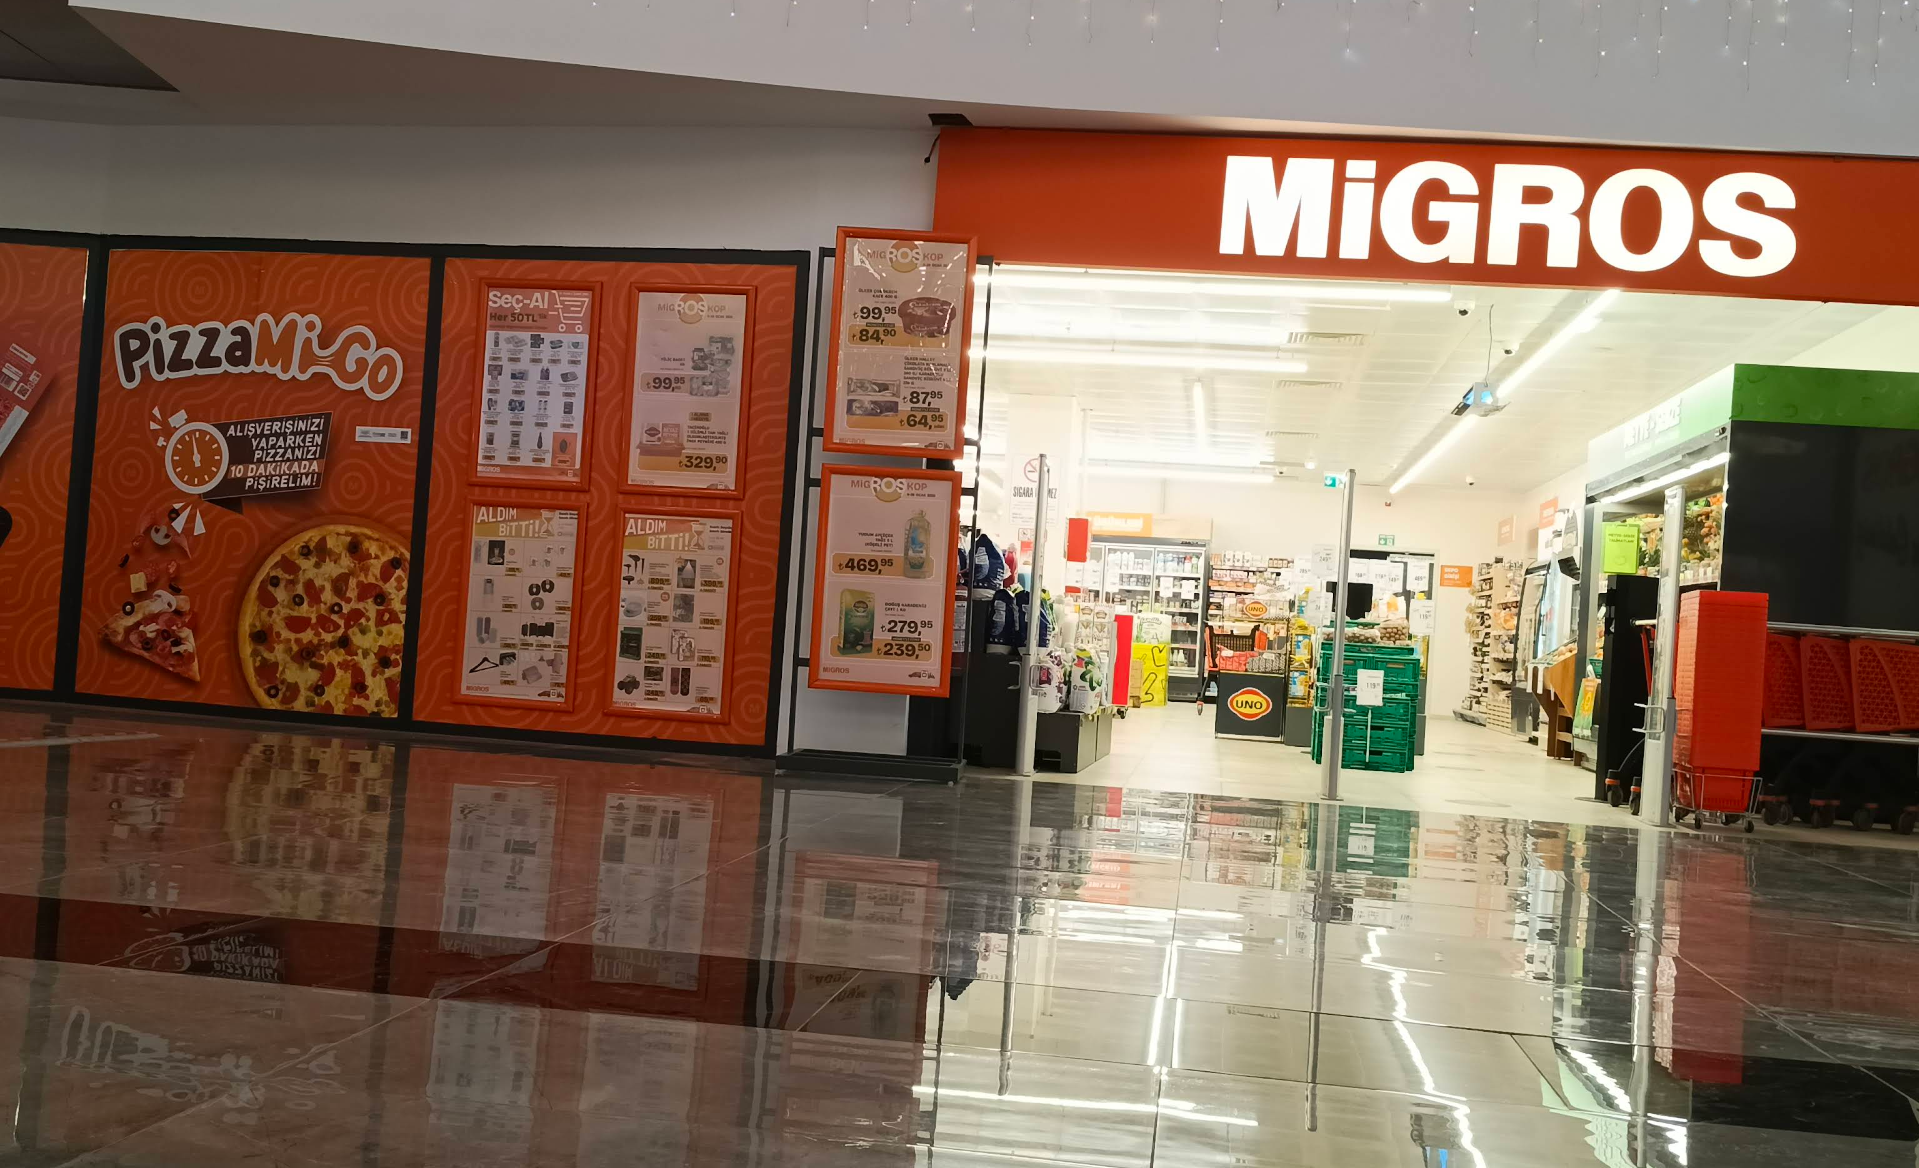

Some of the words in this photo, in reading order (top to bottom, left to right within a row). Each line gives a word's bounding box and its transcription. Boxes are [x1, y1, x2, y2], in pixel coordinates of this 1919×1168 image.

[252, 433, 323, 450] YAPARKEN
[230, 464, 244, 478] 10
[477, 506, 517, 523] ALDIM
[625, 519, 666, 536] ALDIM
[1248, 605, 1264, 613] UNO
[1235, 699, 1263, 710] UNO
